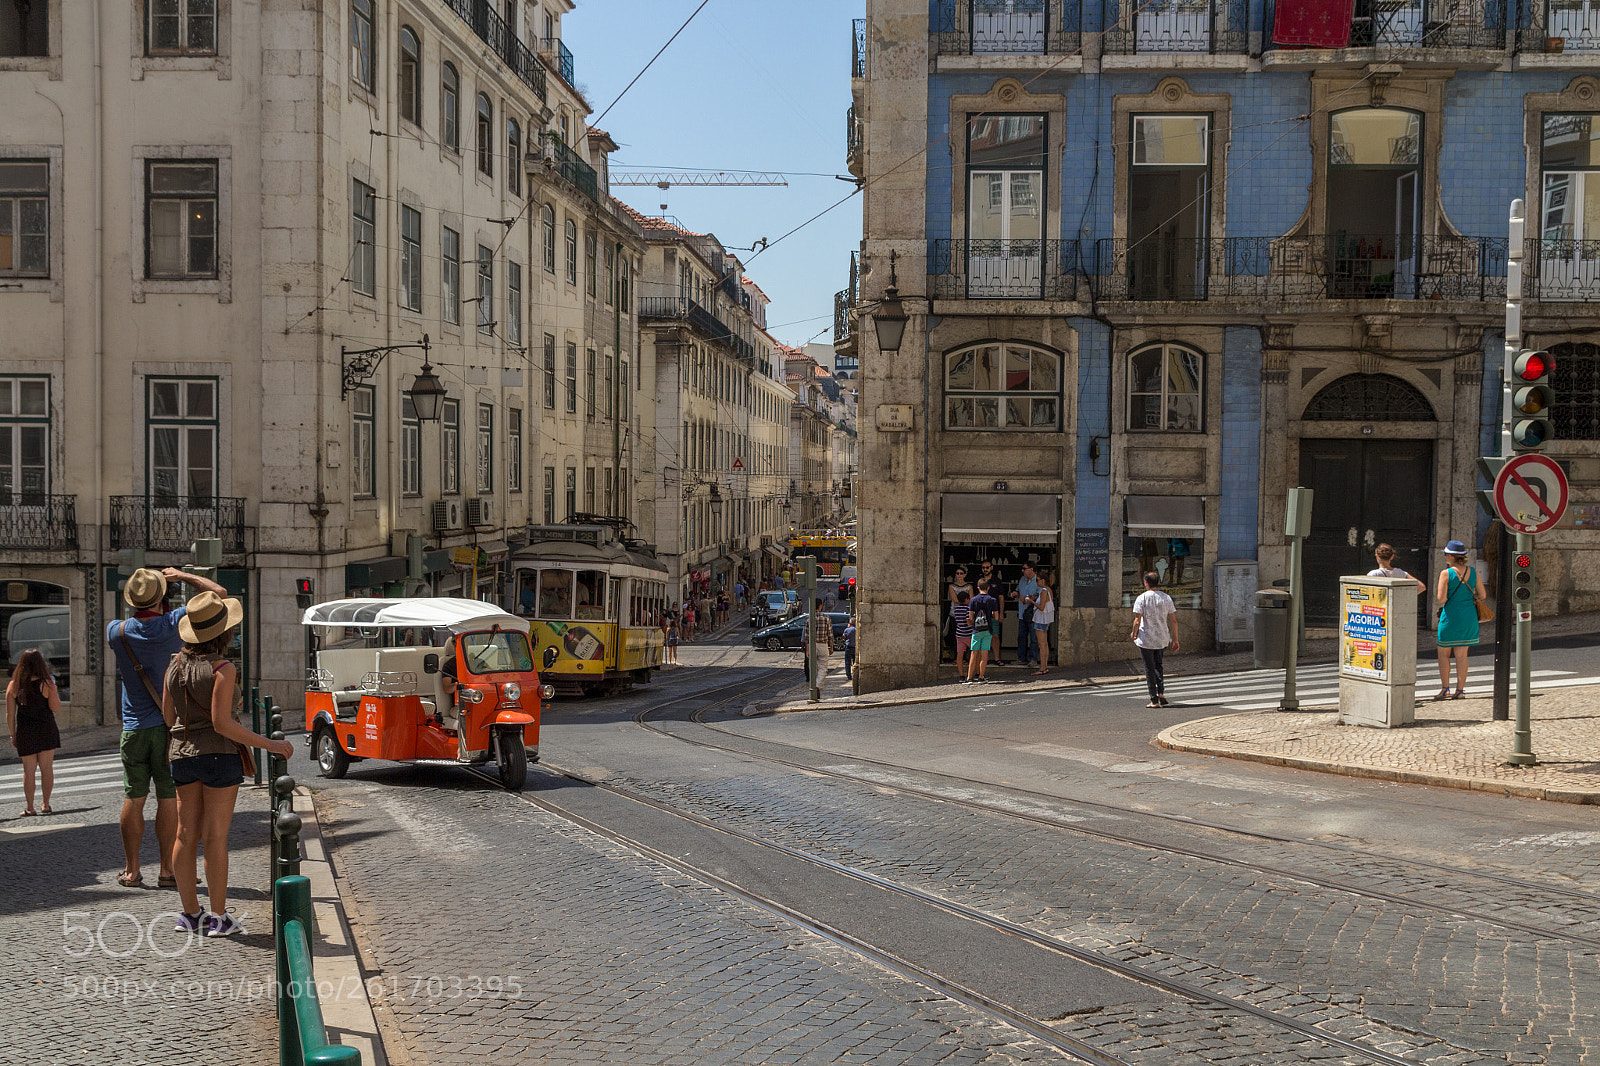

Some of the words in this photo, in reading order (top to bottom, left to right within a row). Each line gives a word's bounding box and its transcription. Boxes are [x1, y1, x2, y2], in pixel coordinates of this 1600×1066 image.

[580, 532, 594, 540] 28
[1349, 613, 1380, 627] AGORIA
[1344, 624, 1364, 632] DAMIAN
